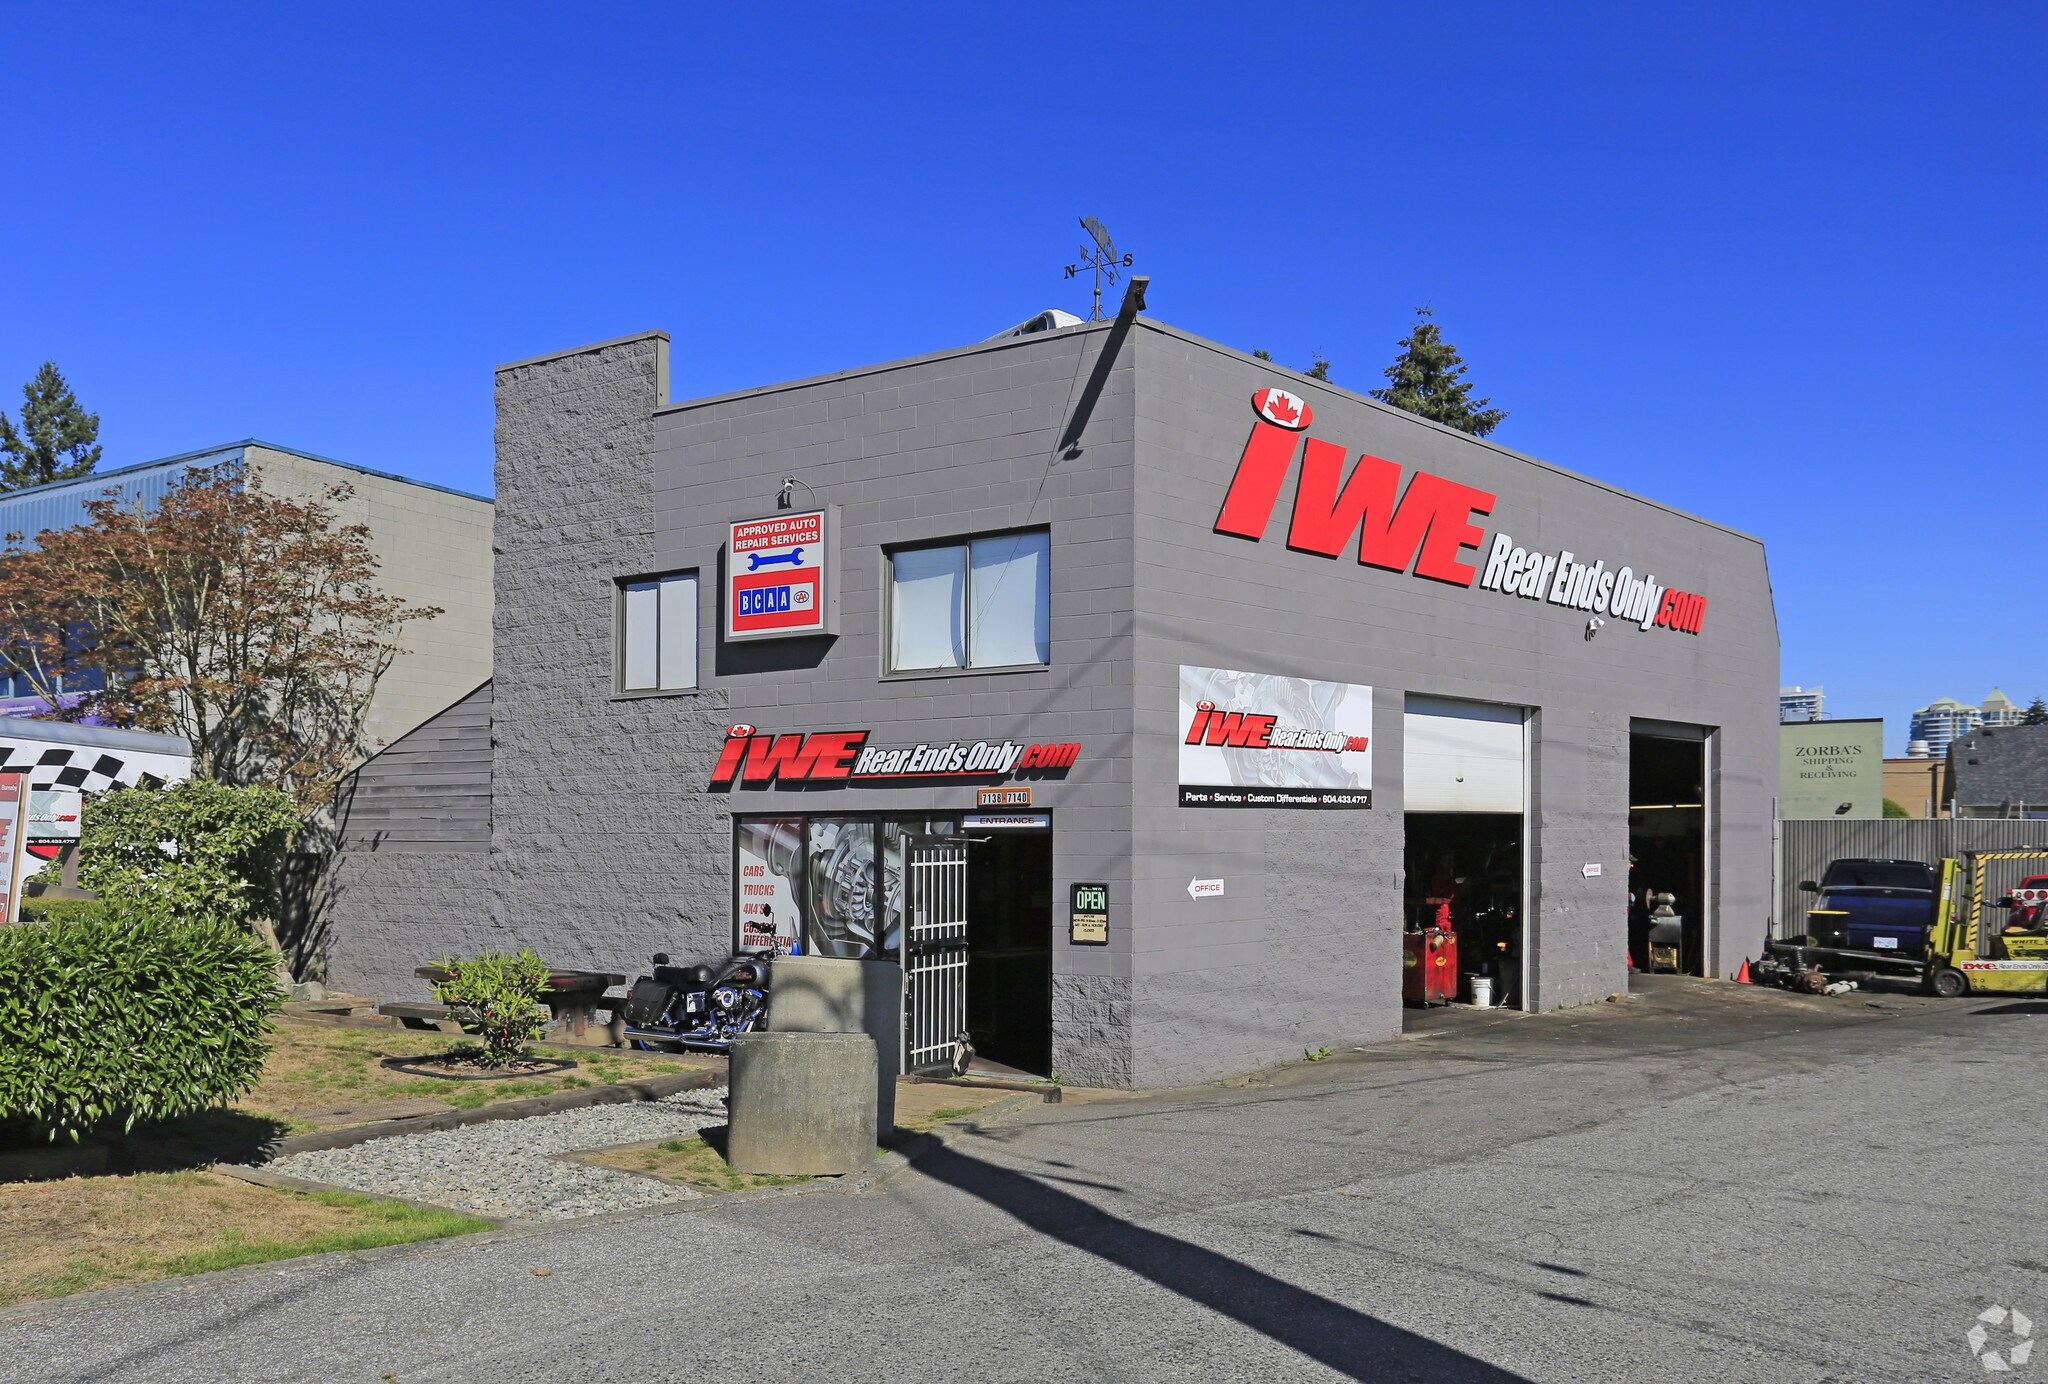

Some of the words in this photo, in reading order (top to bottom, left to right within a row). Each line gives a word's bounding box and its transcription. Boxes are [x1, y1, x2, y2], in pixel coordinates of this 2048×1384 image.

[1123, 253, 1133, 267] S
[1064, 265, 1076, 279] N
[737, 523, 787, 537] APPROVED
[790, 518, 817, 530] AUTO
[736, 537, 768, 550] REPAIR
[771, 531, 818, 545] SERVICES
[742, 591, 787, 610] BCAA
[1796, 745, 1862, 757] ZORBA'S
[1803, 757, 1853, 765] SHIPPING
[983, 794, 1001, 803] 7138
[1008, 793, 1027, 802] 7140
[1185, 792, 1208, 801] Parts
[1214, 793, 1242, 802] Service
[1247, 793, 1275, 802] Custom
[1276, 794, 1318, 804] Differentials
[1322, 795, 1368, 804] 604.433.4717
[743, 866, 764, 877] CARS
[743, 885, 775, 896] TRUCKS
[1194, 884, 1221, 892] OFFICE
[1076, 891, 1105, 910] OPEN
